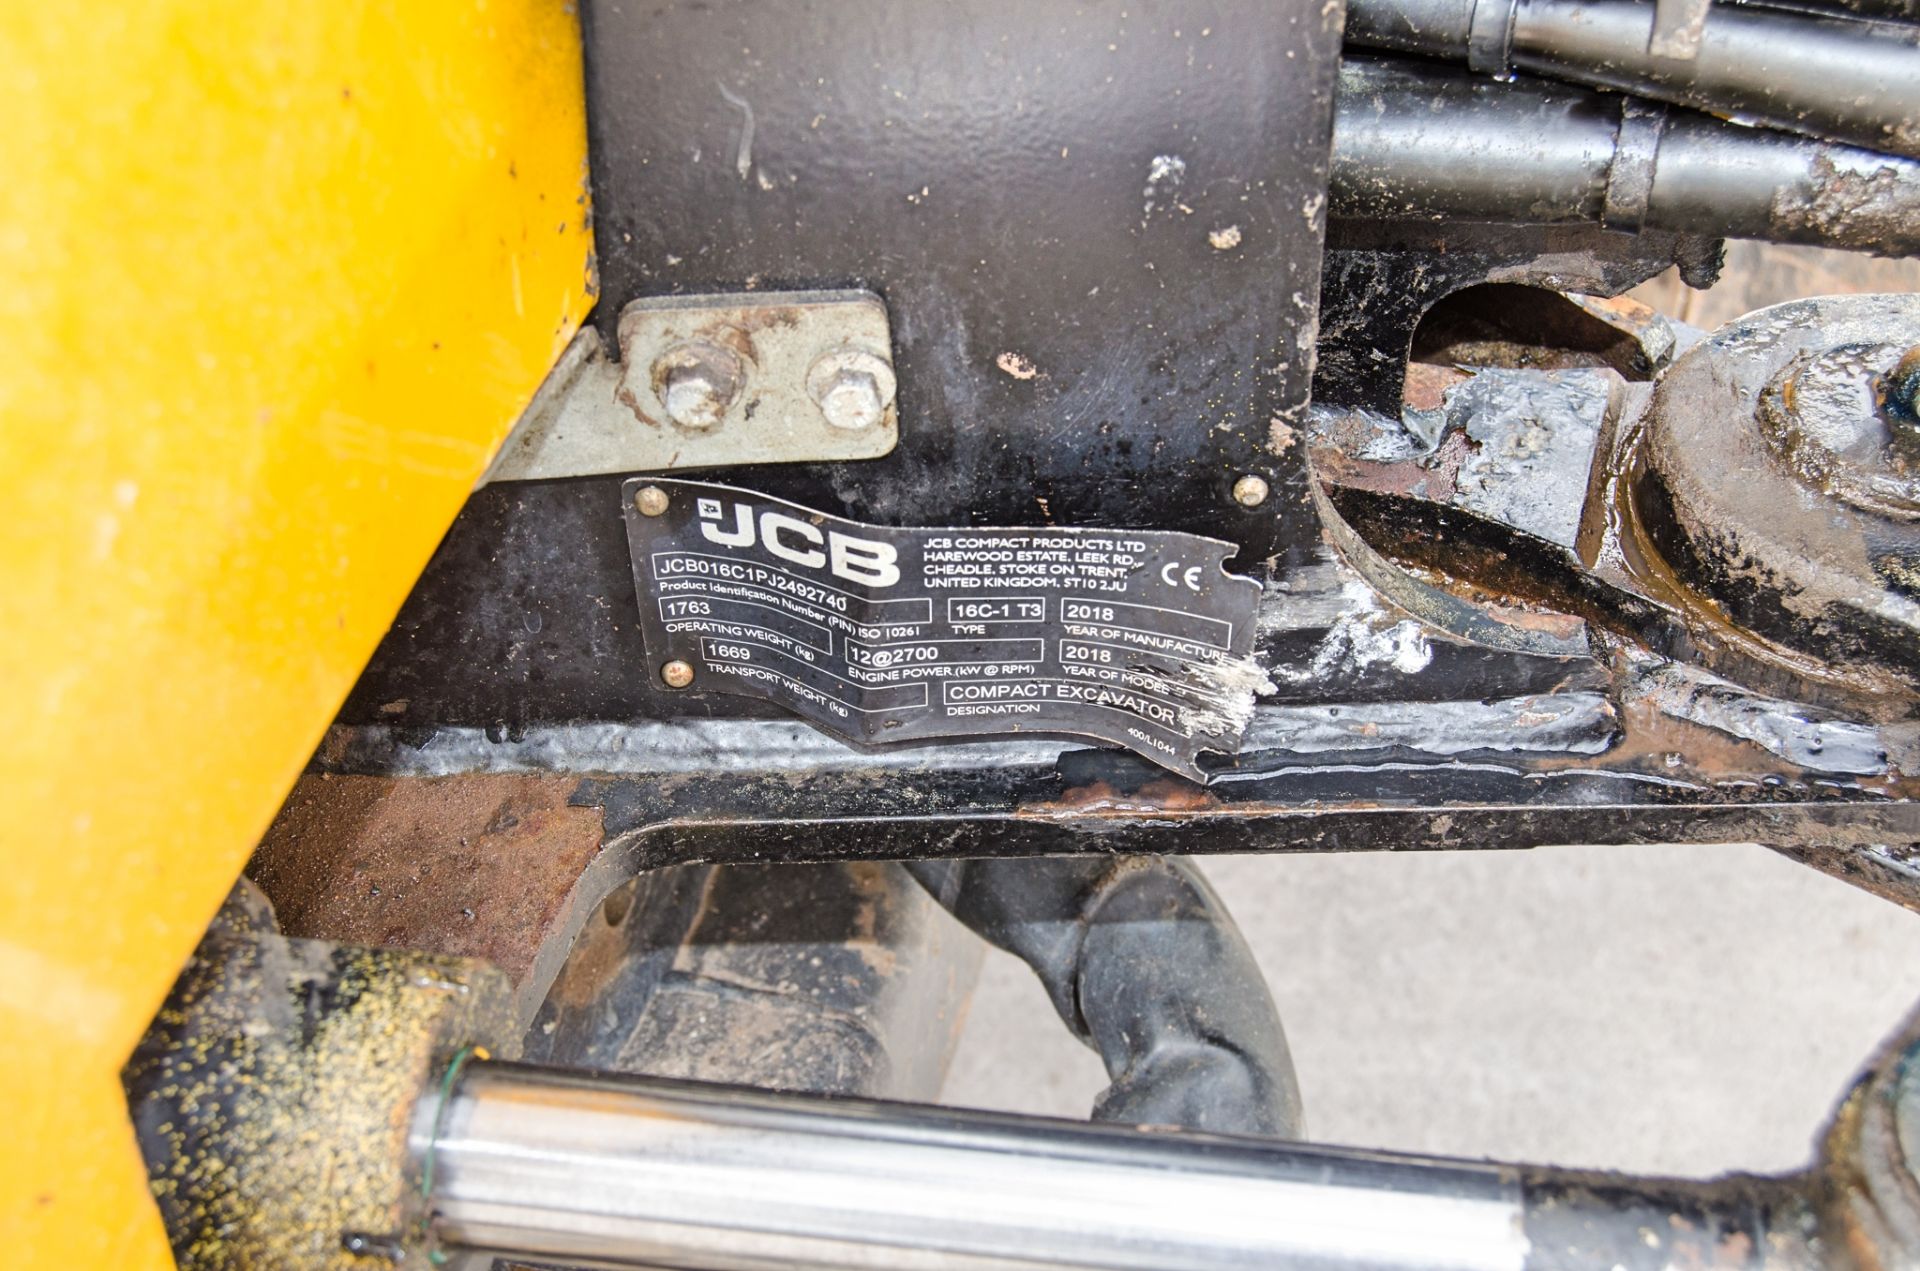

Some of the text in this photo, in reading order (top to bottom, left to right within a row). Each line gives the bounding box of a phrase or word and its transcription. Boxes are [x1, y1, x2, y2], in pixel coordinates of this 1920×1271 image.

[698, 498, 900, 587] JCB
[923, 538, 1146, 552] JCB COMPACT PRODUCTS LTD
[923, 551, 1013, 562] HAREWOOD
[1075, 552, 1109, 564] LEEK
[999, 564, 1047, 574] STOKE
[1050, 564, 1075, 575] ON
[660, 558, 847, 611] JCB016C1PJ2492740
[924, 577, 981, 588] UNITED
[1064, 578, 1097, 589] ST10
[1100, 581, 1127, 592] 2JU
[660, 580, 920, 638] Product Identification Number (PIN) ISO 10261
[667, 602, 711, 616] 1763
[956, 603, 1042, 618] 16C-1 T3
[1067, 605, 1114, 621] 2018
[951, 625, 986, 634] TYPE
[1064, 625, 1098, 637] YEAR
[1101, 628, 1121, 639] OF
[666, 622, 814, 661] OPERATING WEIGHT (kg)
[708, 644, 750, 660] 1669
[851, 647, 938, 667] 12@2700
[1065, 646, 1111, 662] 2018
[848, 665, 1035, 682] ENGINE POWER (kW @ RPM)
[1063, 665, 1096, 678] YEAR
[1099, 670, 1119, 680] OF
[707, 663, 848, 717] TRANSPORT WEIGHT (kg)
[947, 704, 1040, 716] DESIGNATION
[950, 684, 1174, 725] COMPACT EXCAVATOR
